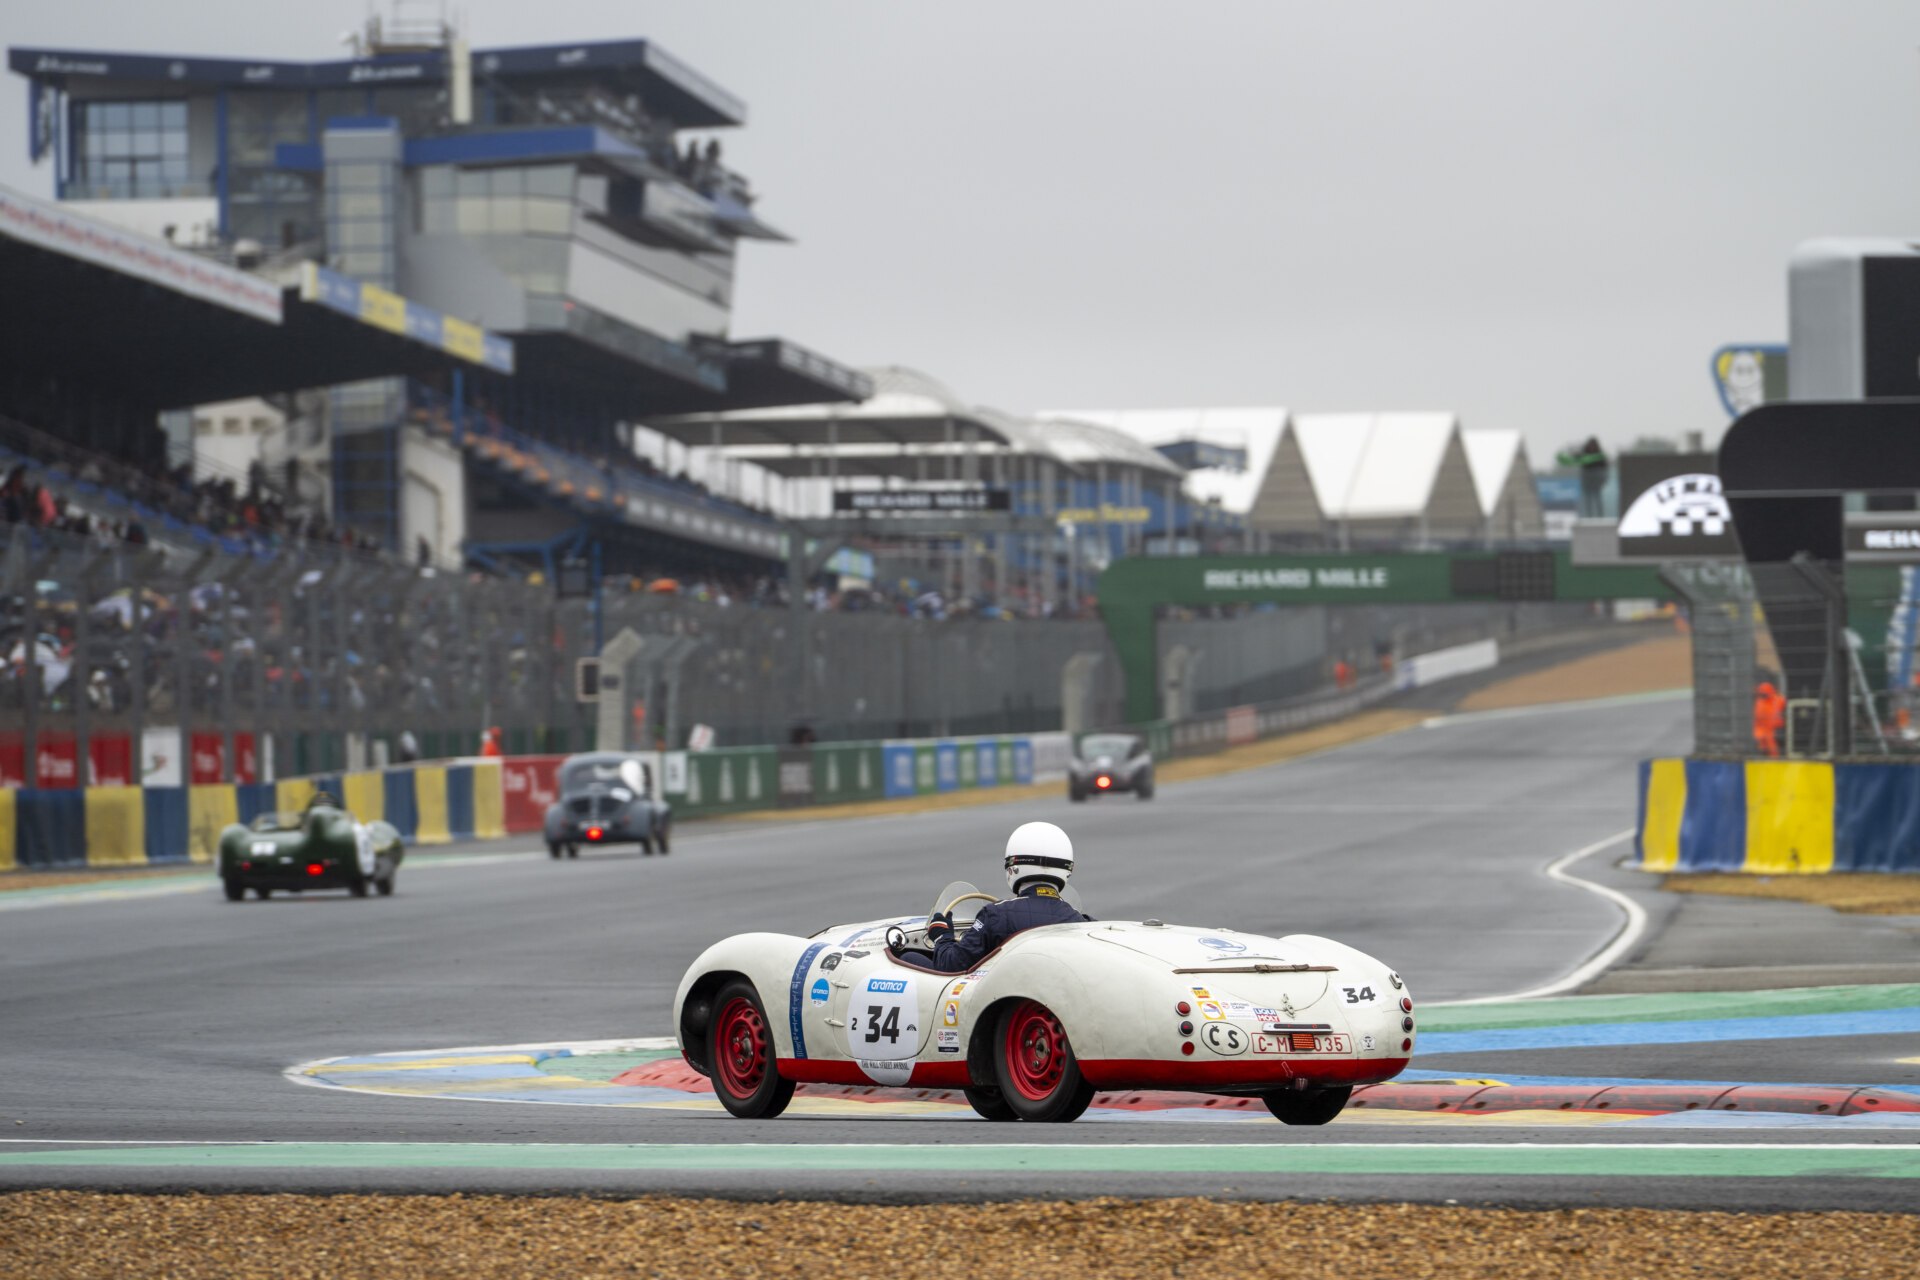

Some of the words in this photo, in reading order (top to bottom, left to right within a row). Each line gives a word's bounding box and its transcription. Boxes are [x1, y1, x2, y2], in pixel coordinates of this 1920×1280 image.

[935, 494, 988, 508] MILLE
[1204, 569, 1311, 589] RICHARD
[1316, 567, 1388, 588] MILLE
[870, 981, 903, 992] aramco
[1342, 986, 1376, 1004] 34
[851, 1017, 858, 1031] 2
[864, 1004, 901, 1044] 34
[1257, 1014, 1280, 1022] MOLY
